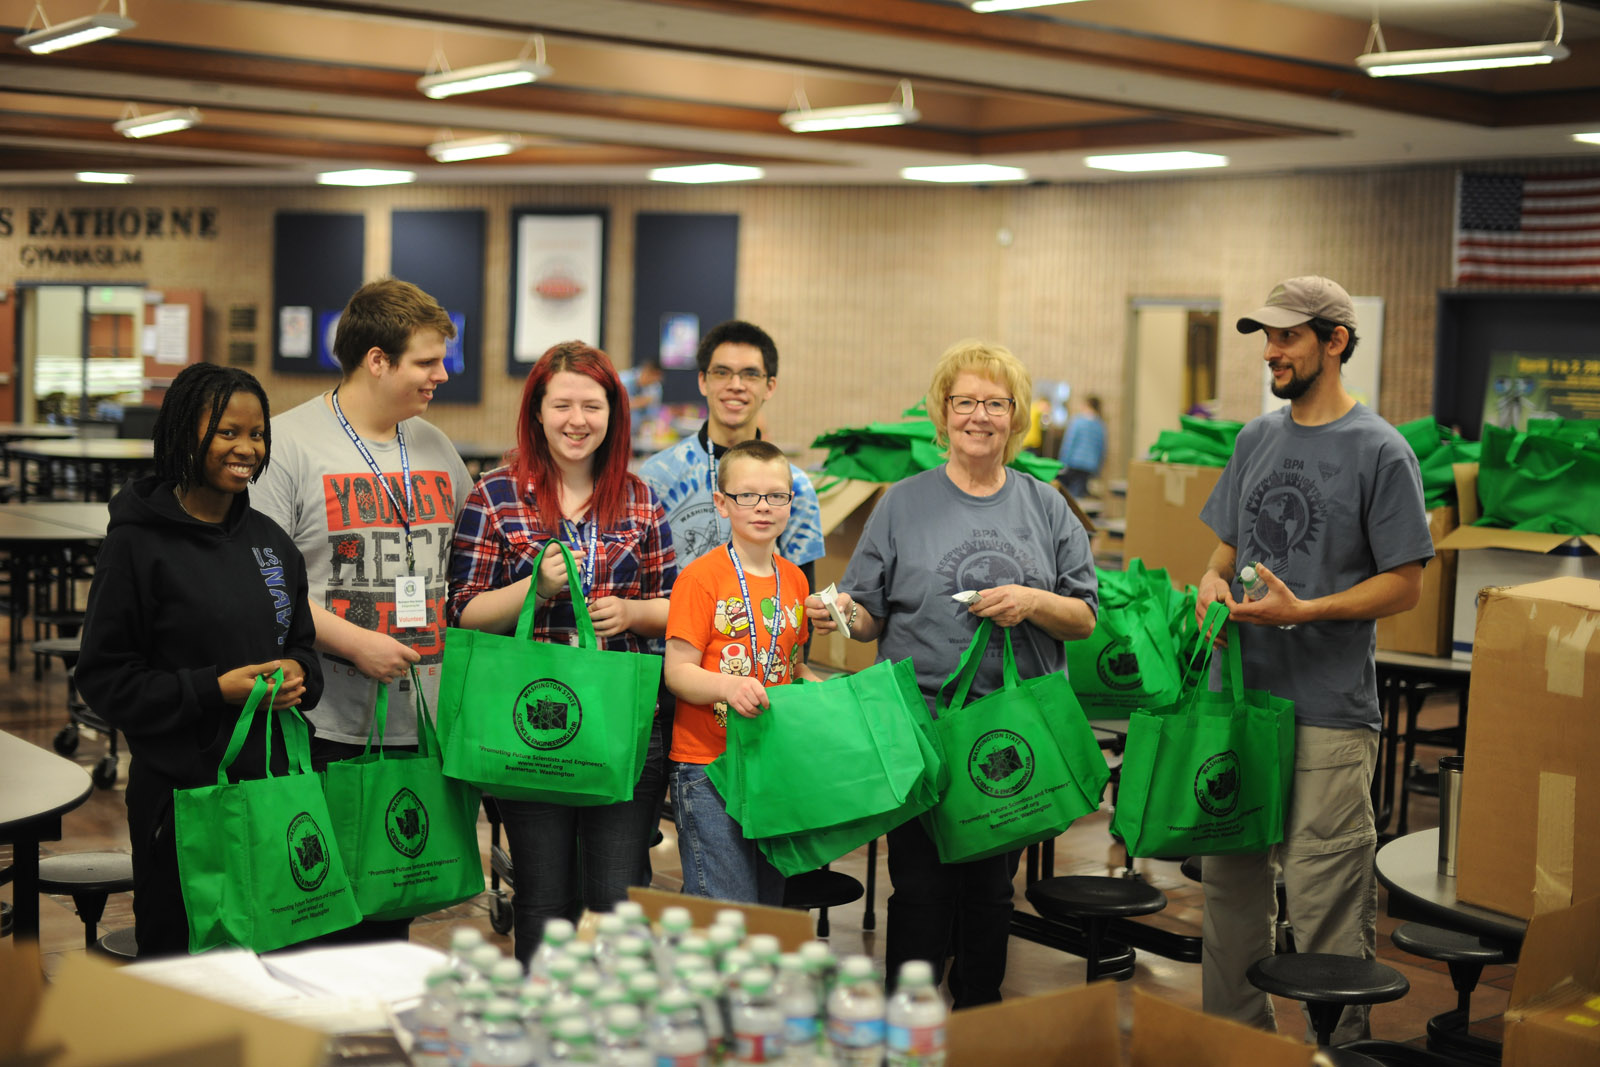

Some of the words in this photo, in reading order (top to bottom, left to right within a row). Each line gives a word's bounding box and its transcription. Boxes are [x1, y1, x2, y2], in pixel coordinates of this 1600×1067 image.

[28, 206, 218, 239] EATHORNE
[21, 244, 142, 267] GYMNASIUM
[344, 423, 359, 440] State
[354, 438, 373, 464] Science
[370, 462, 381, 475] and
[1283, 458, 1305, 470] BPA
[330, 474, 436, 526] YOUNG
[680, 507, 714, 523] WASHING
[972, 529, 999, 538] BPA
[729, 548, 743, 579] Washington
[740, 578, 748, 596] State
[744, 596, 754, 622] Science
[522, 682, 562, 699] WASHINGTON
[561, 689, 577, 707] STATE
[517, 712, 528, 738] SCIENCE
[531, 733, 569, 747] ENGINEERING
[568, 721, 578, 735] FAIR
[512, 751, 531, 759] Future
[532, 754, 561, 763] Scientists
[972, 733, 1004, 762] WASHINGTON
[1005, 733, 1022, 746] STATE
[518, 760, 564, 771] www.wssef.org
[540, 769, 575, 778] Washington
[975, 776, 993, 793] SCIENCE
[1000, 769, 1030, 795] ENGINEERING
[990, 806, 1008, 815] Future
[1008, 796, 1033, 808] Scientists
[1034, 791, 1044, 799] and
[1021, 803, 1052, 818] Washington
